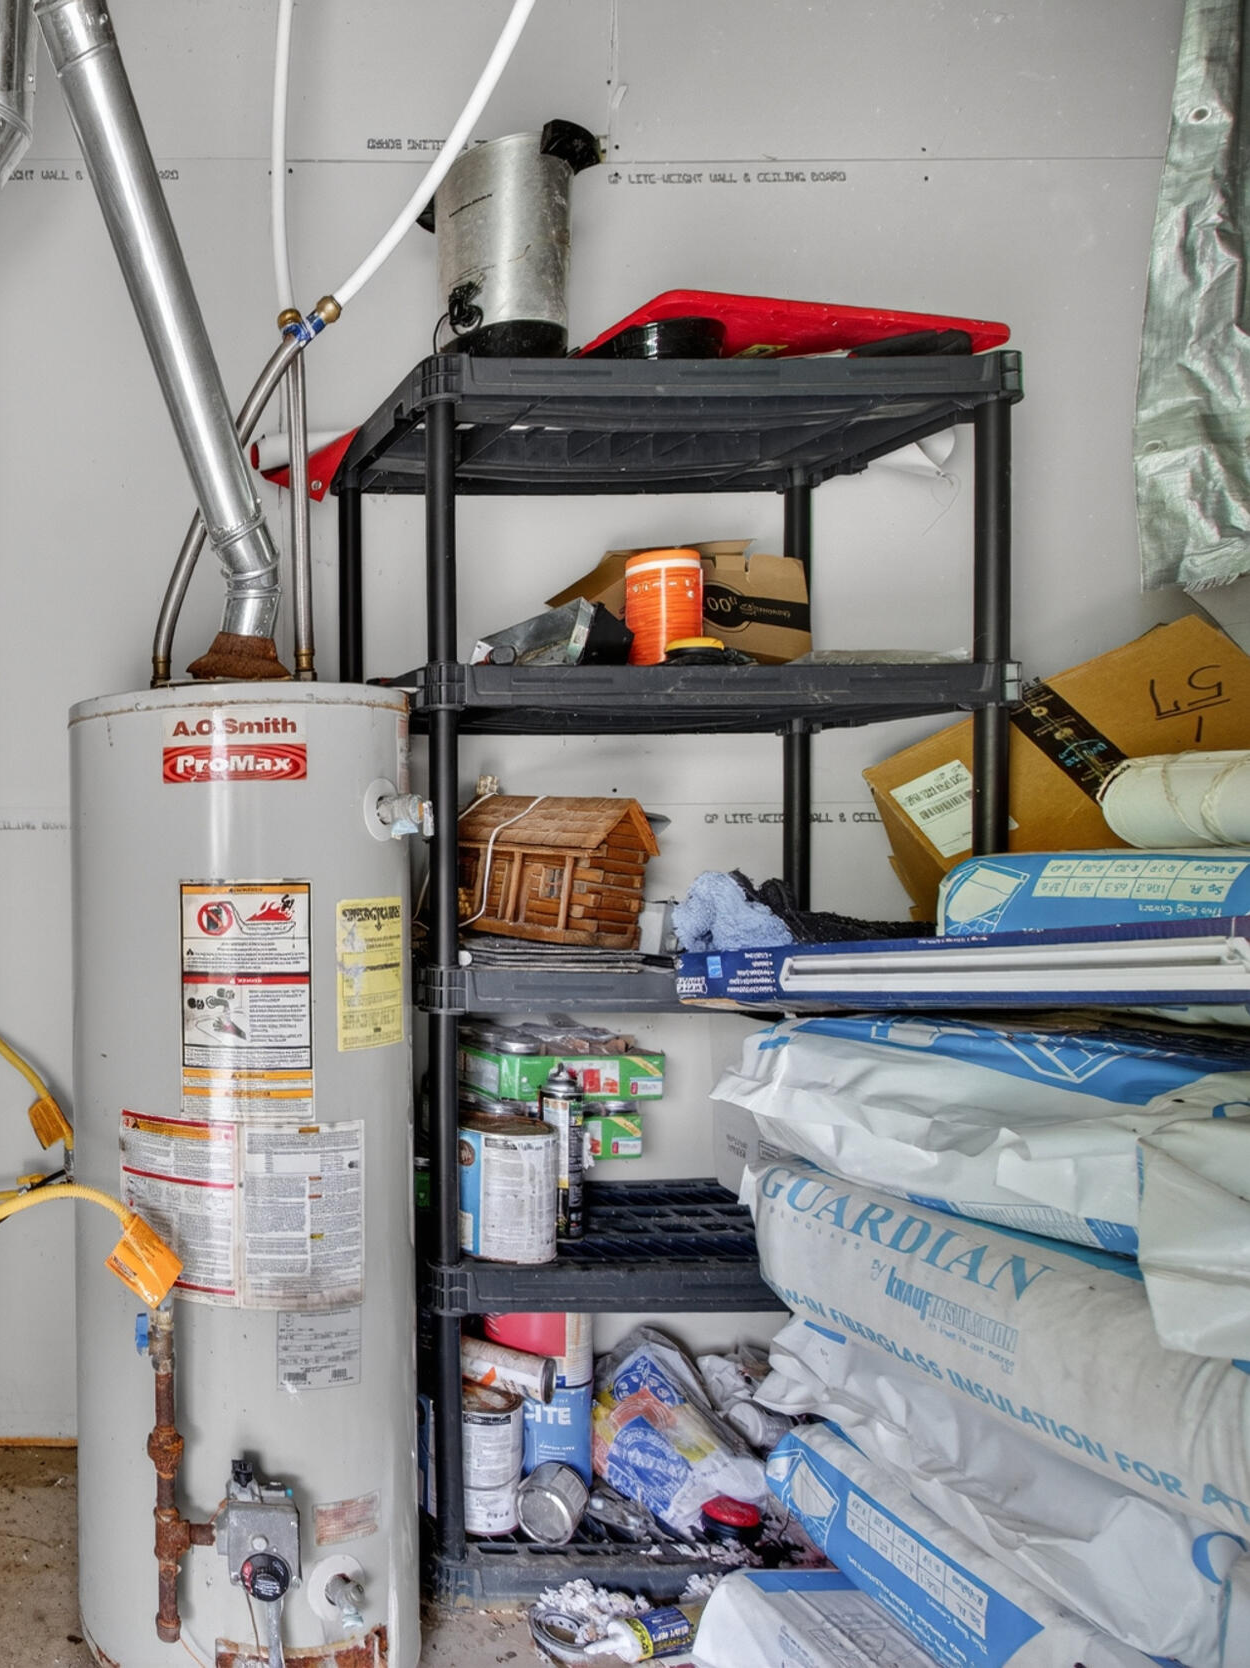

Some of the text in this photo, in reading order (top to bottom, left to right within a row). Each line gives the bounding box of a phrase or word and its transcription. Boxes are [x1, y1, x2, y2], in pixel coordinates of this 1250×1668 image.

[224, 717, 297, 736] Smith
[176, 754, 292, 775] ProMax
[761, 1166, 1056, 1302] GUARDIAN
[524, 1400, 572, 1425] ITE
[829, 1307, 944, 1380] FIBERGLASS
[946, 1368, 1109, 1465] INSULATION
[1114, 1451, 1191, 1499] FOR
